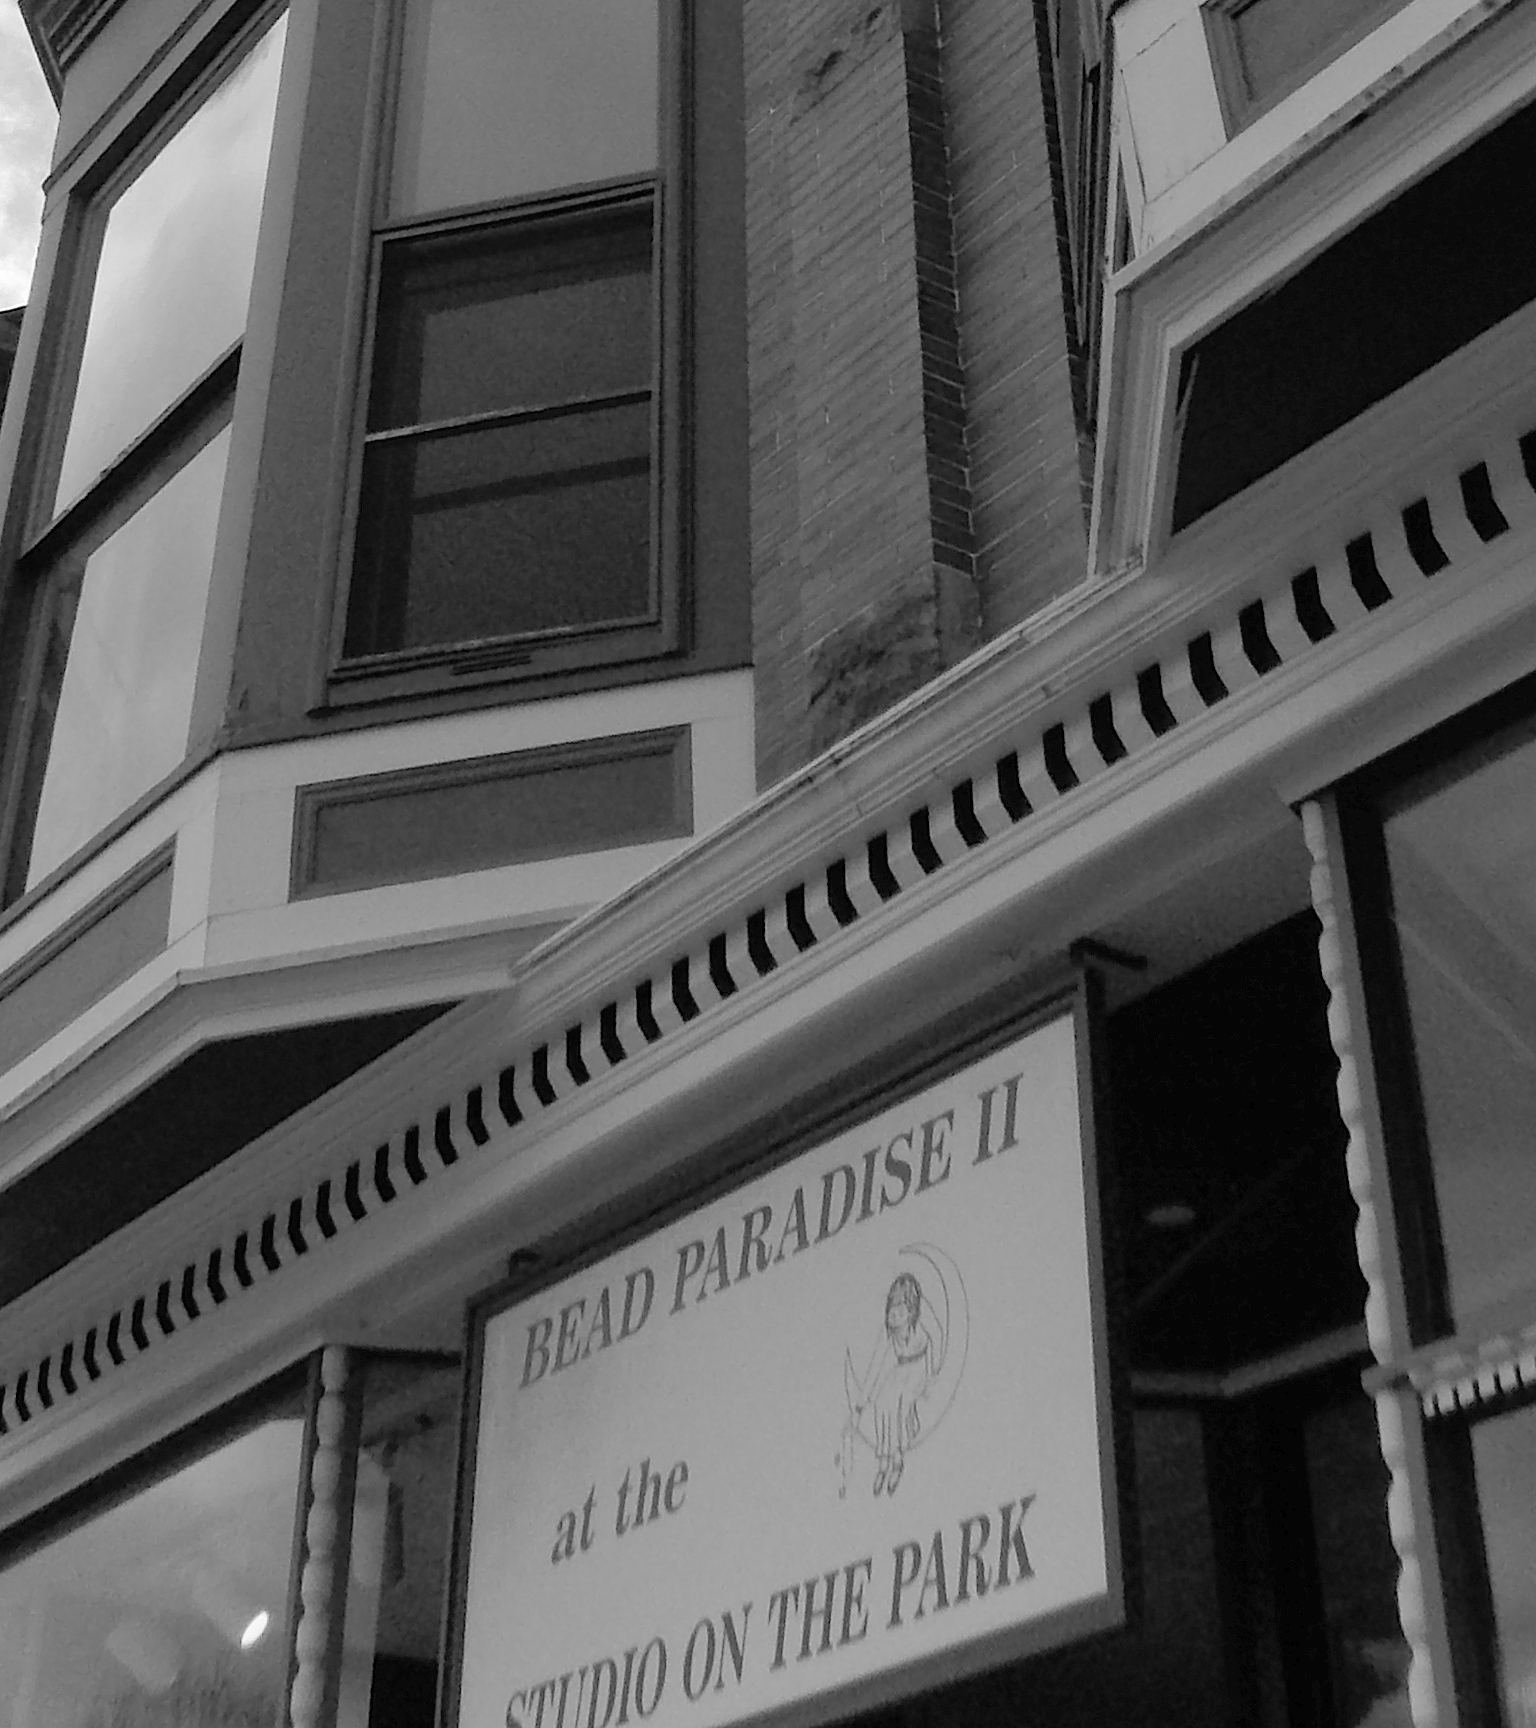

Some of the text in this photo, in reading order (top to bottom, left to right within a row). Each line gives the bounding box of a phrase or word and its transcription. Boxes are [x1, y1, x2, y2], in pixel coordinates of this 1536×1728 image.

[519, 1073, 1024, 1389] BEAD PARADISE II
[550, 1457, 689, 1566] at the
[682, 1601, 753, 1701] ON
[767, 1557, 873, 1671] THE
[886, 1493, 1037, 1630] PARK
